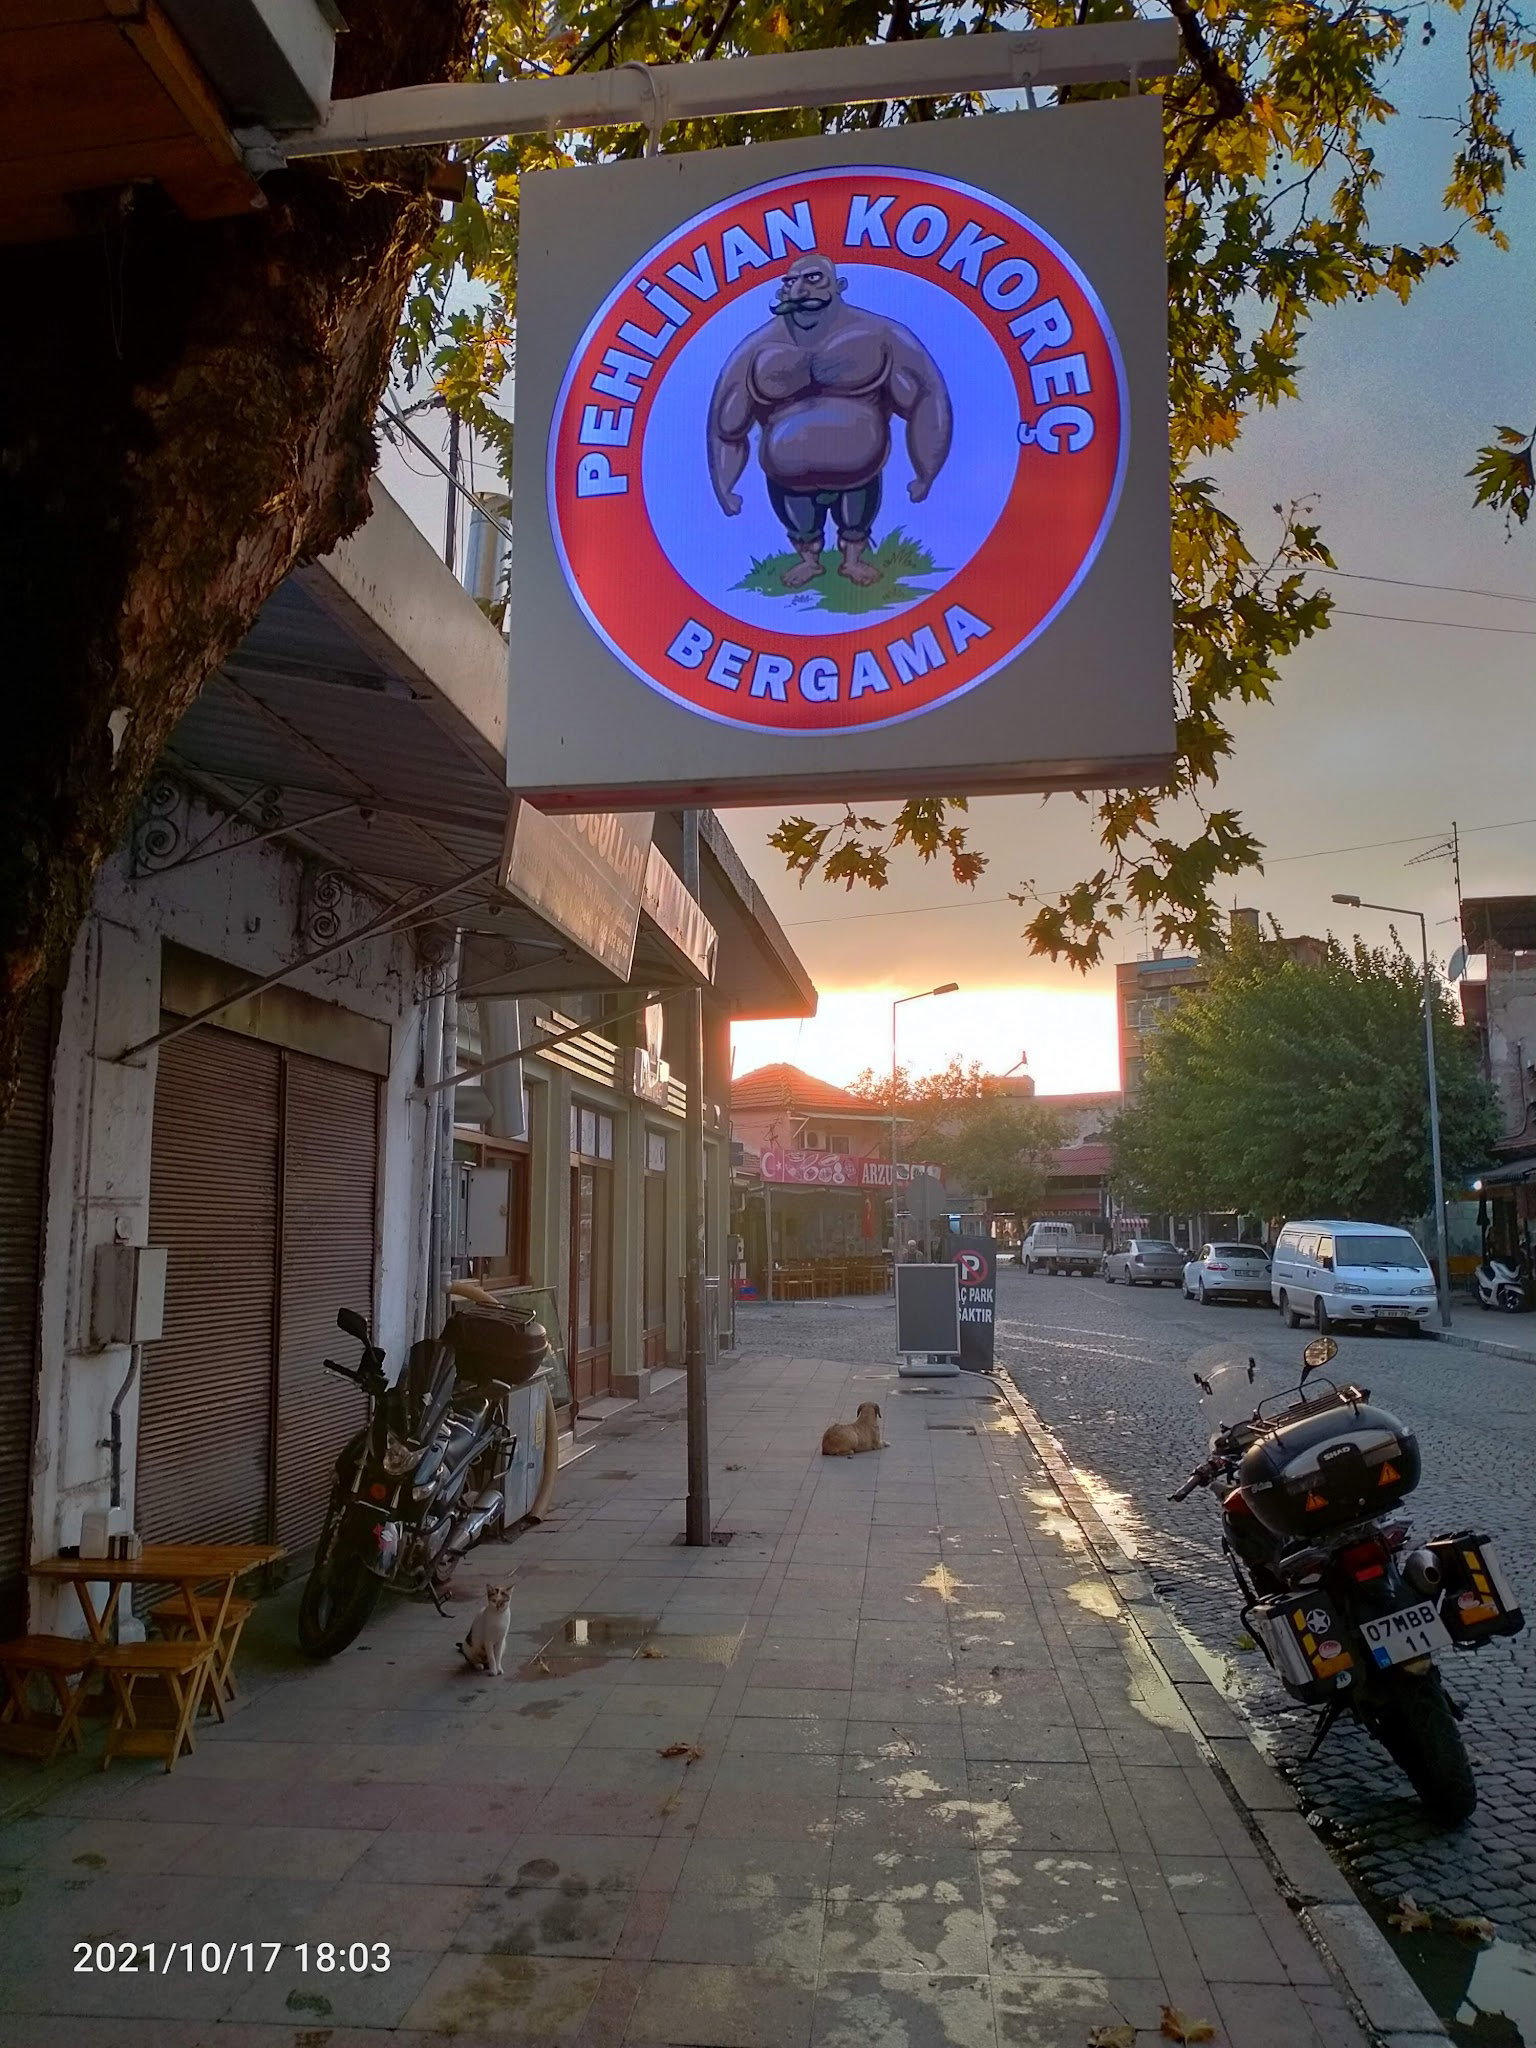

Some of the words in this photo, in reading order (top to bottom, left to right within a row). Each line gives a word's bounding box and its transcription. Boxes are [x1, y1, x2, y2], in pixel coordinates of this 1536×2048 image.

[843, 194, 1096, 457] KOKOREÇ
[665, 603, 995, 703] BERGAMA
[862, 1162, 893, 1186] ARZU
[969, 1287, 993, 1303] PARK
[1323, 1446, 1351, 1461] SHAD
[1406, 1631, 1431, 1652] 11
